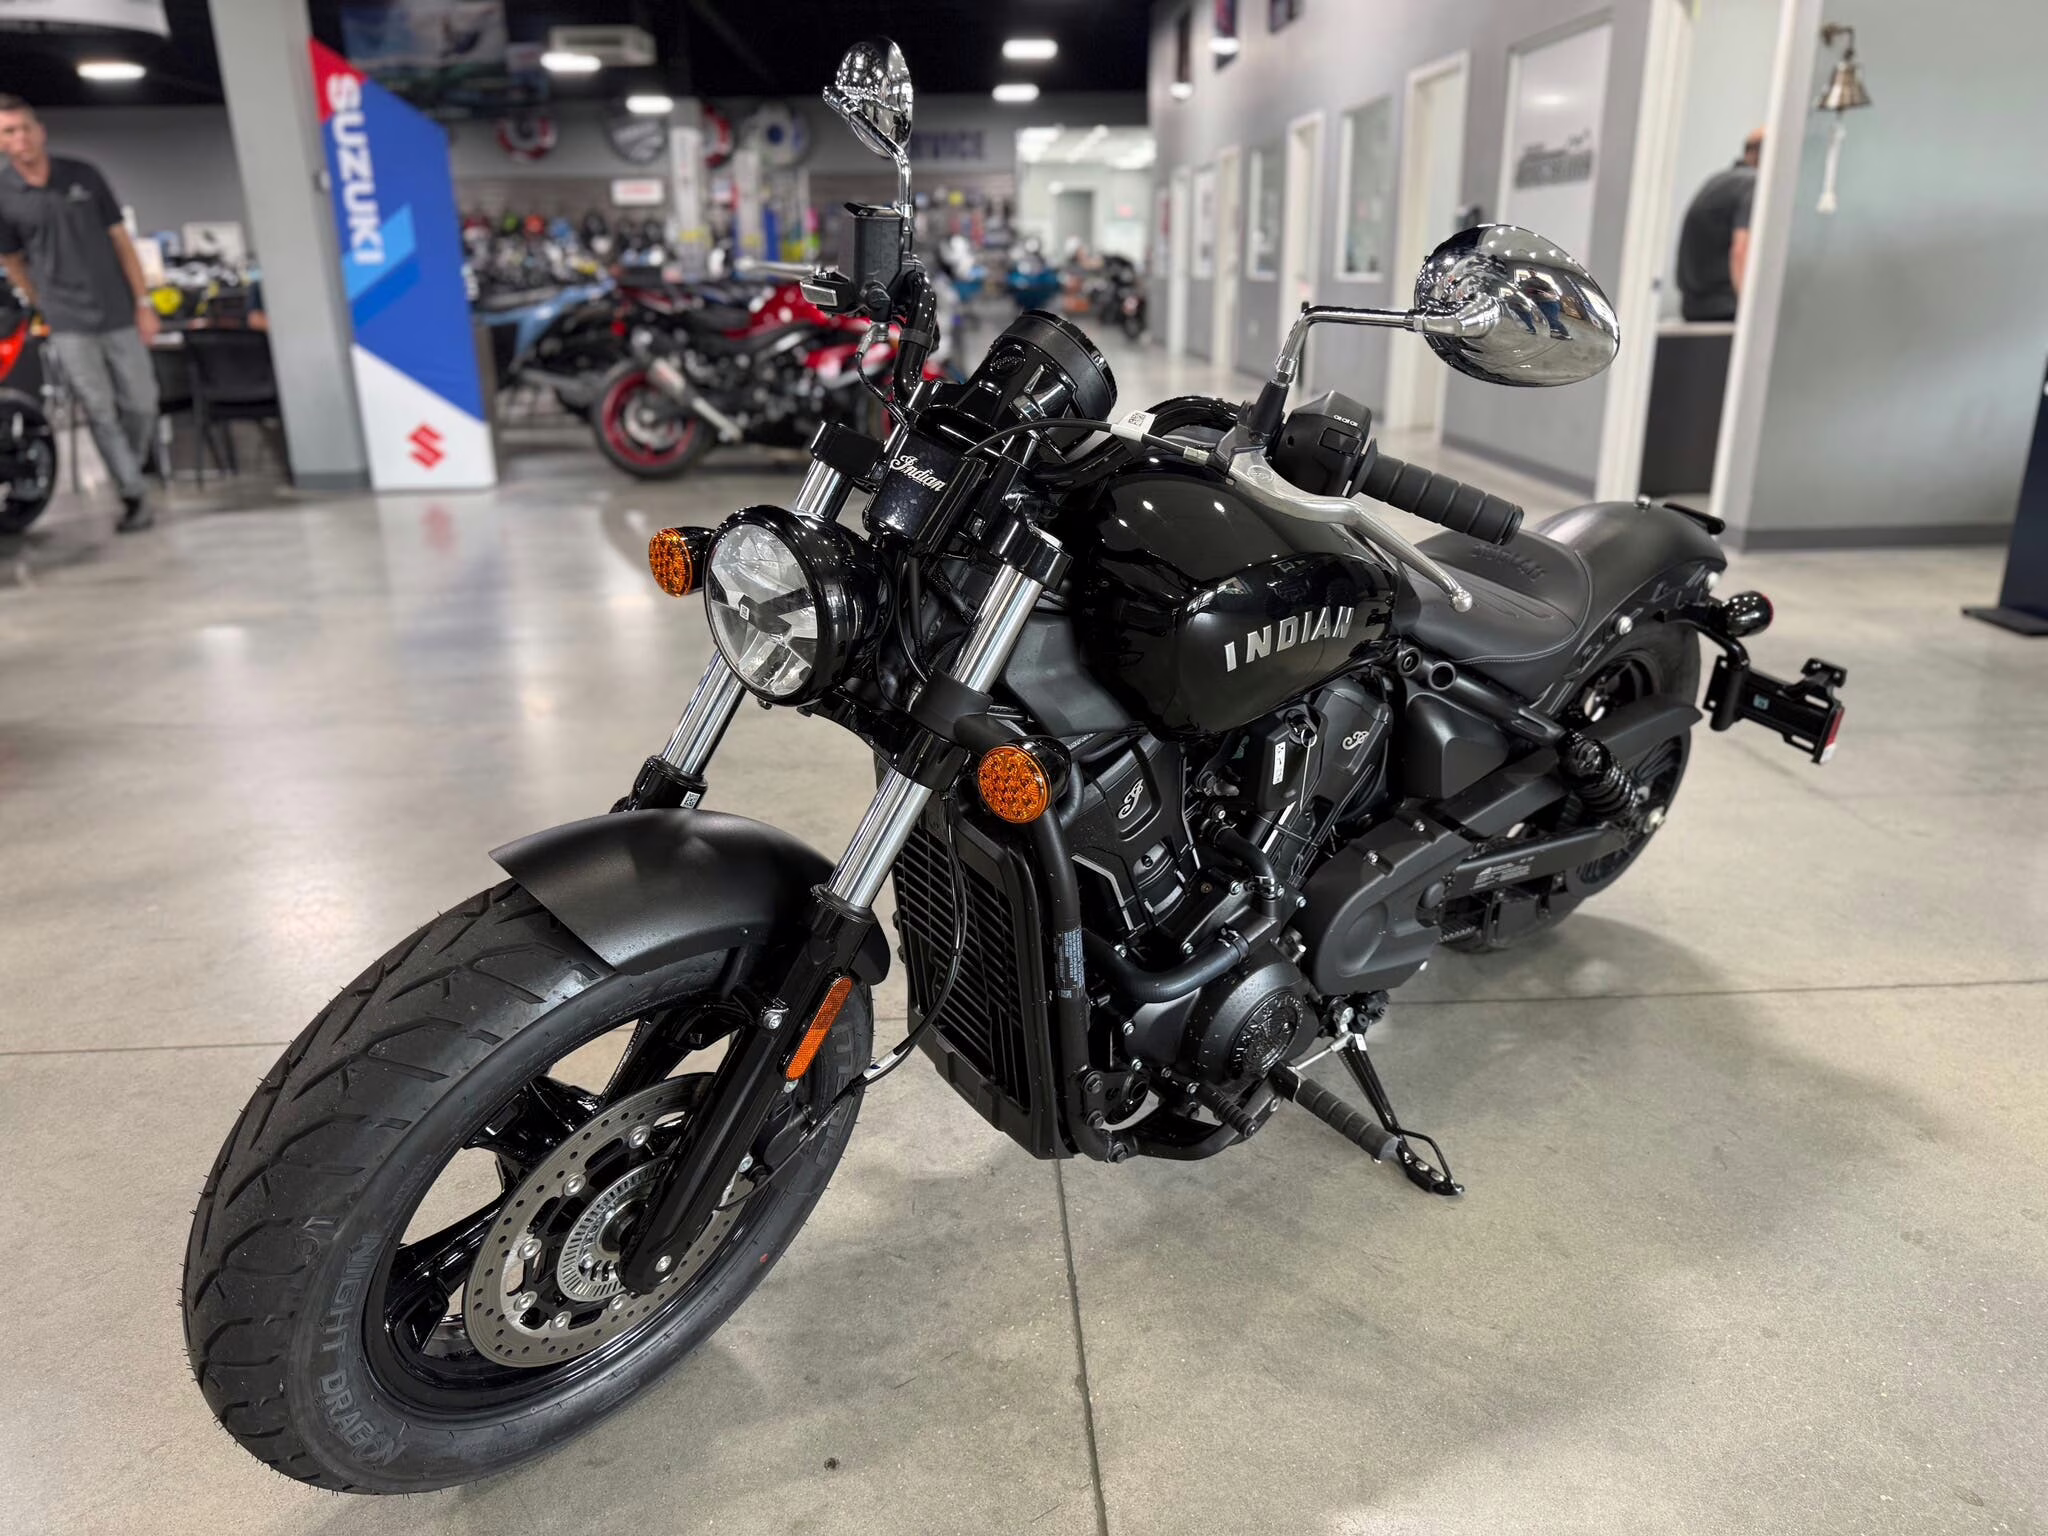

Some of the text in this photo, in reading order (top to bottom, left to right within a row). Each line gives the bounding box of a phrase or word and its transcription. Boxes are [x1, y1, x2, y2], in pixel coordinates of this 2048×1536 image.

[326, 73, 385, 265] SUZUKI
[890, 455, 947, 491] Indian
[1224, 605, 1355, 672] INDIAN
[320, 1233, 409, 1467] NIGHT DRAGON
